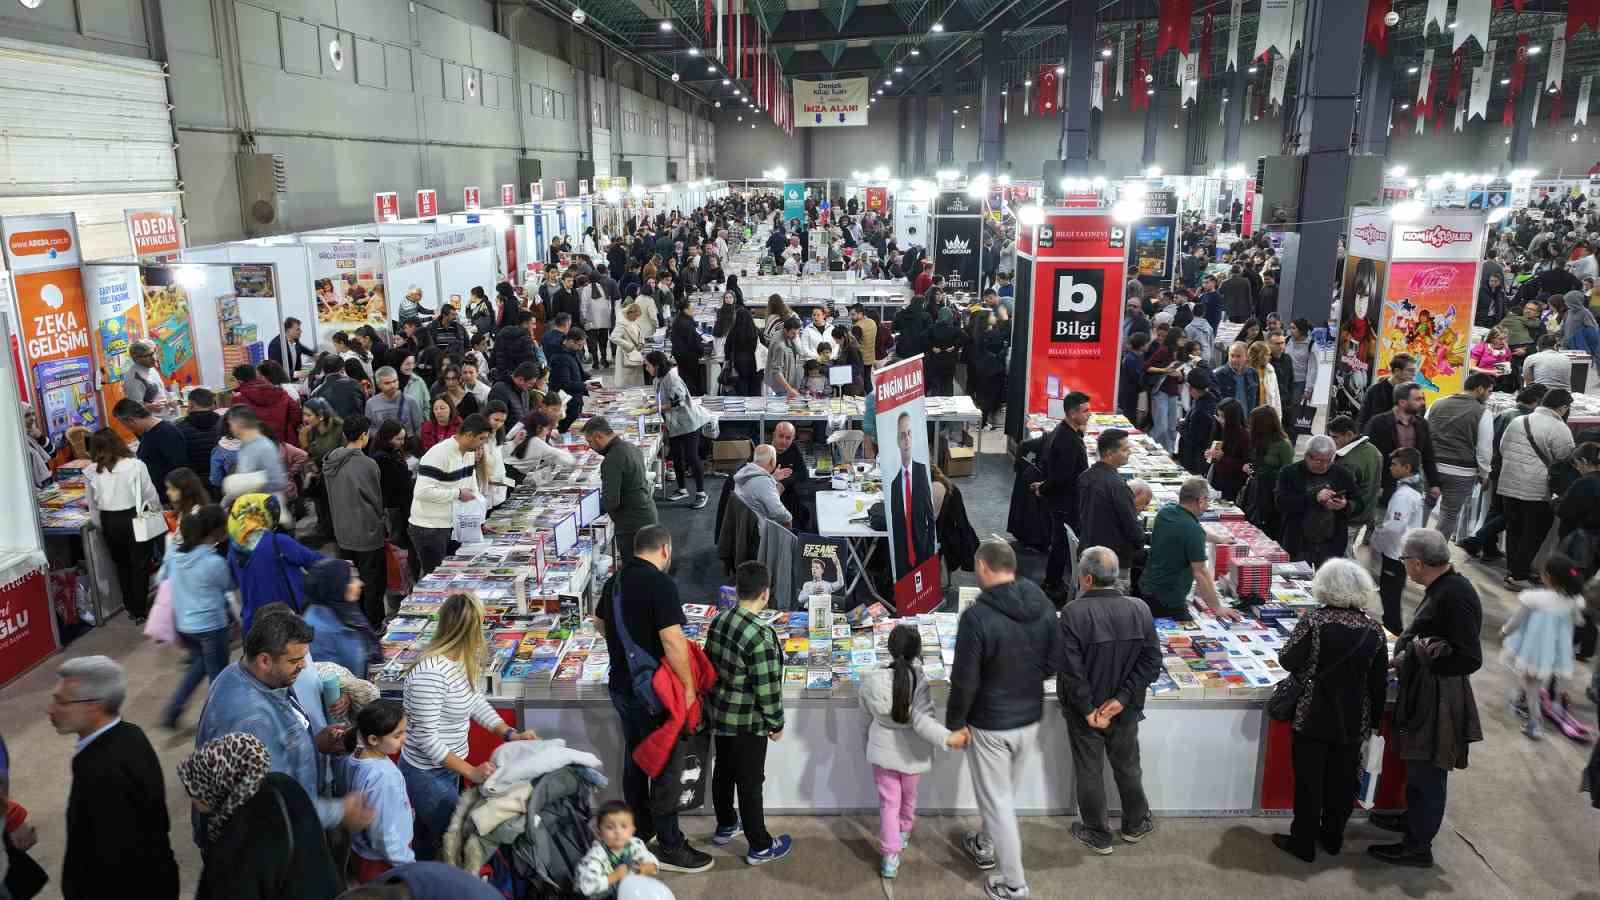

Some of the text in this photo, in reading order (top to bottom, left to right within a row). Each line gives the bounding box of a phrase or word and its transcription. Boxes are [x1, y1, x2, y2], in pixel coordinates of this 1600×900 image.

[134, 217, 176, 236] ADEDA
[1058, 275, 1097, 312] b
[33, 311, 78, 337] ZEKA
[1056, 320, 1096, 340] Bilgi
[28, 327, 89, 359] GELİŞİMİ
[878, 375, 903, 401] ENGİN
[904, 369, 922, 391] ALAN
[803, 544, 838, 554] EFSANE
